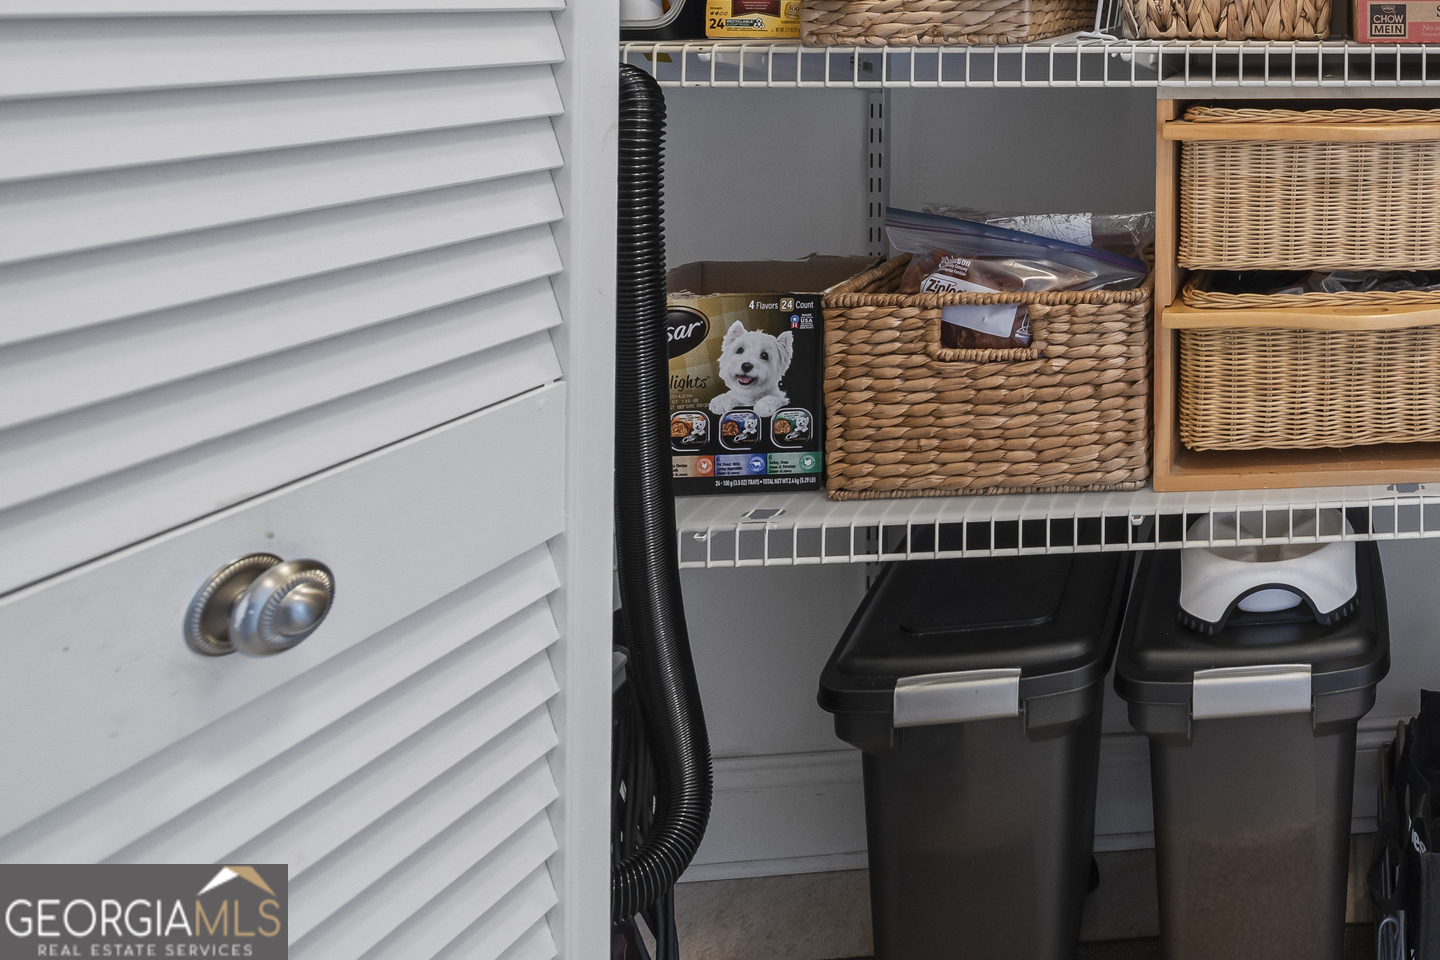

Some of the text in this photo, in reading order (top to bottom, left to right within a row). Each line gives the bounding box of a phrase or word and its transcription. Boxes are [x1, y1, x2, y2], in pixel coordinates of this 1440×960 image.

[709, 18, 725, 30] 24
[1373, 14, 1404, 24] CHOW
[1373, 25, 1404, 34] MEIN
[1422, 24, 1433, 32] No
[749, 300, 814, 310] 4 Flavors 24 Count
[670, 374, 707, 392] lights
